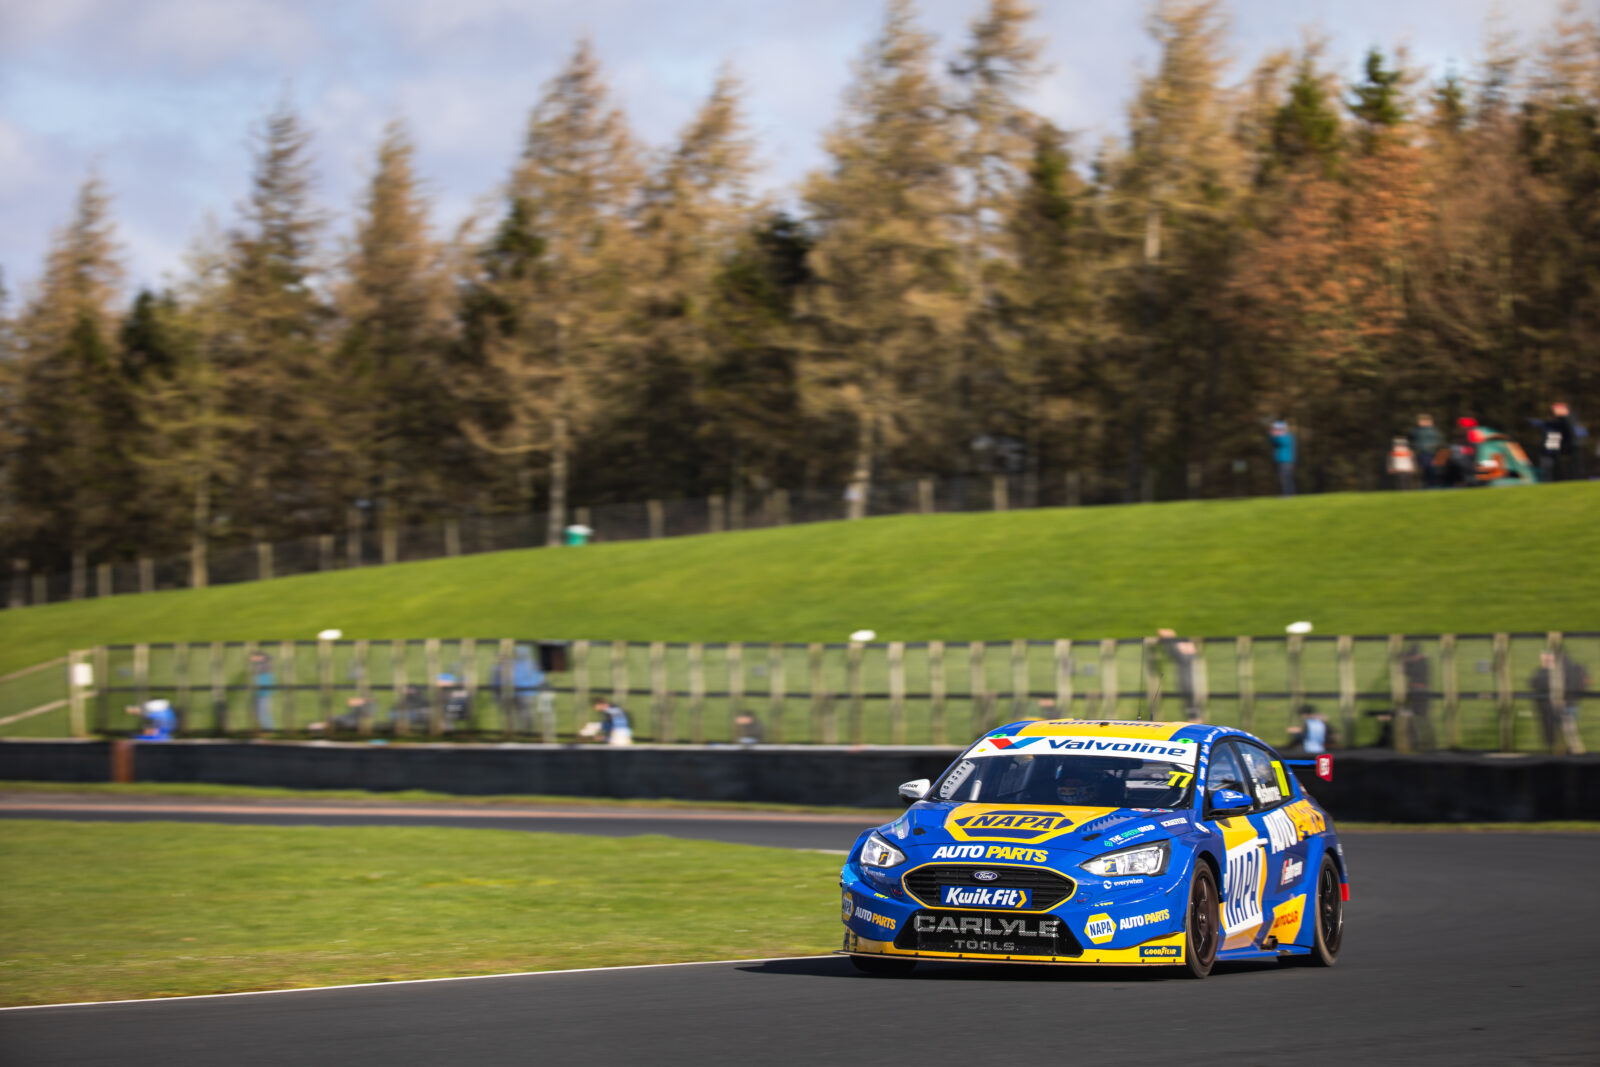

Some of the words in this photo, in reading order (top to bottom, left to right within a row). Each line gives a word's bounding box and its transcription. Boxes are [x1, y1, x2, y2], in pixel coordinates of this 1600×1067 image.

[1048, 739, 1187, 757] Valvoline
[1167, 771, 1194, 788] 77
[970, 815, 1056, 830] NAPA
[1262, 808, 1298, 854] AUTO
[932, 845, 985, 859] AUTO
[984, 846, 1049, 863] PARTS
[1113, 878, 1144, 886] everywhen
[1225, 848, 1259, 928] NAPA
[855, 906, 872, 922] AUTO
[871, 912, 897, 930] PARTS
[913, 915, 1061, 938] CARLYLE
[1119, 915, 1145, 930] AUTO
[1144, 908, 1170, 925] PARTS
[1089, 920, 1113, 937] NAPA
[954, 940, 1016, 951] TOOLS
[1144, 946, 1177, 956] GOODYEAR
